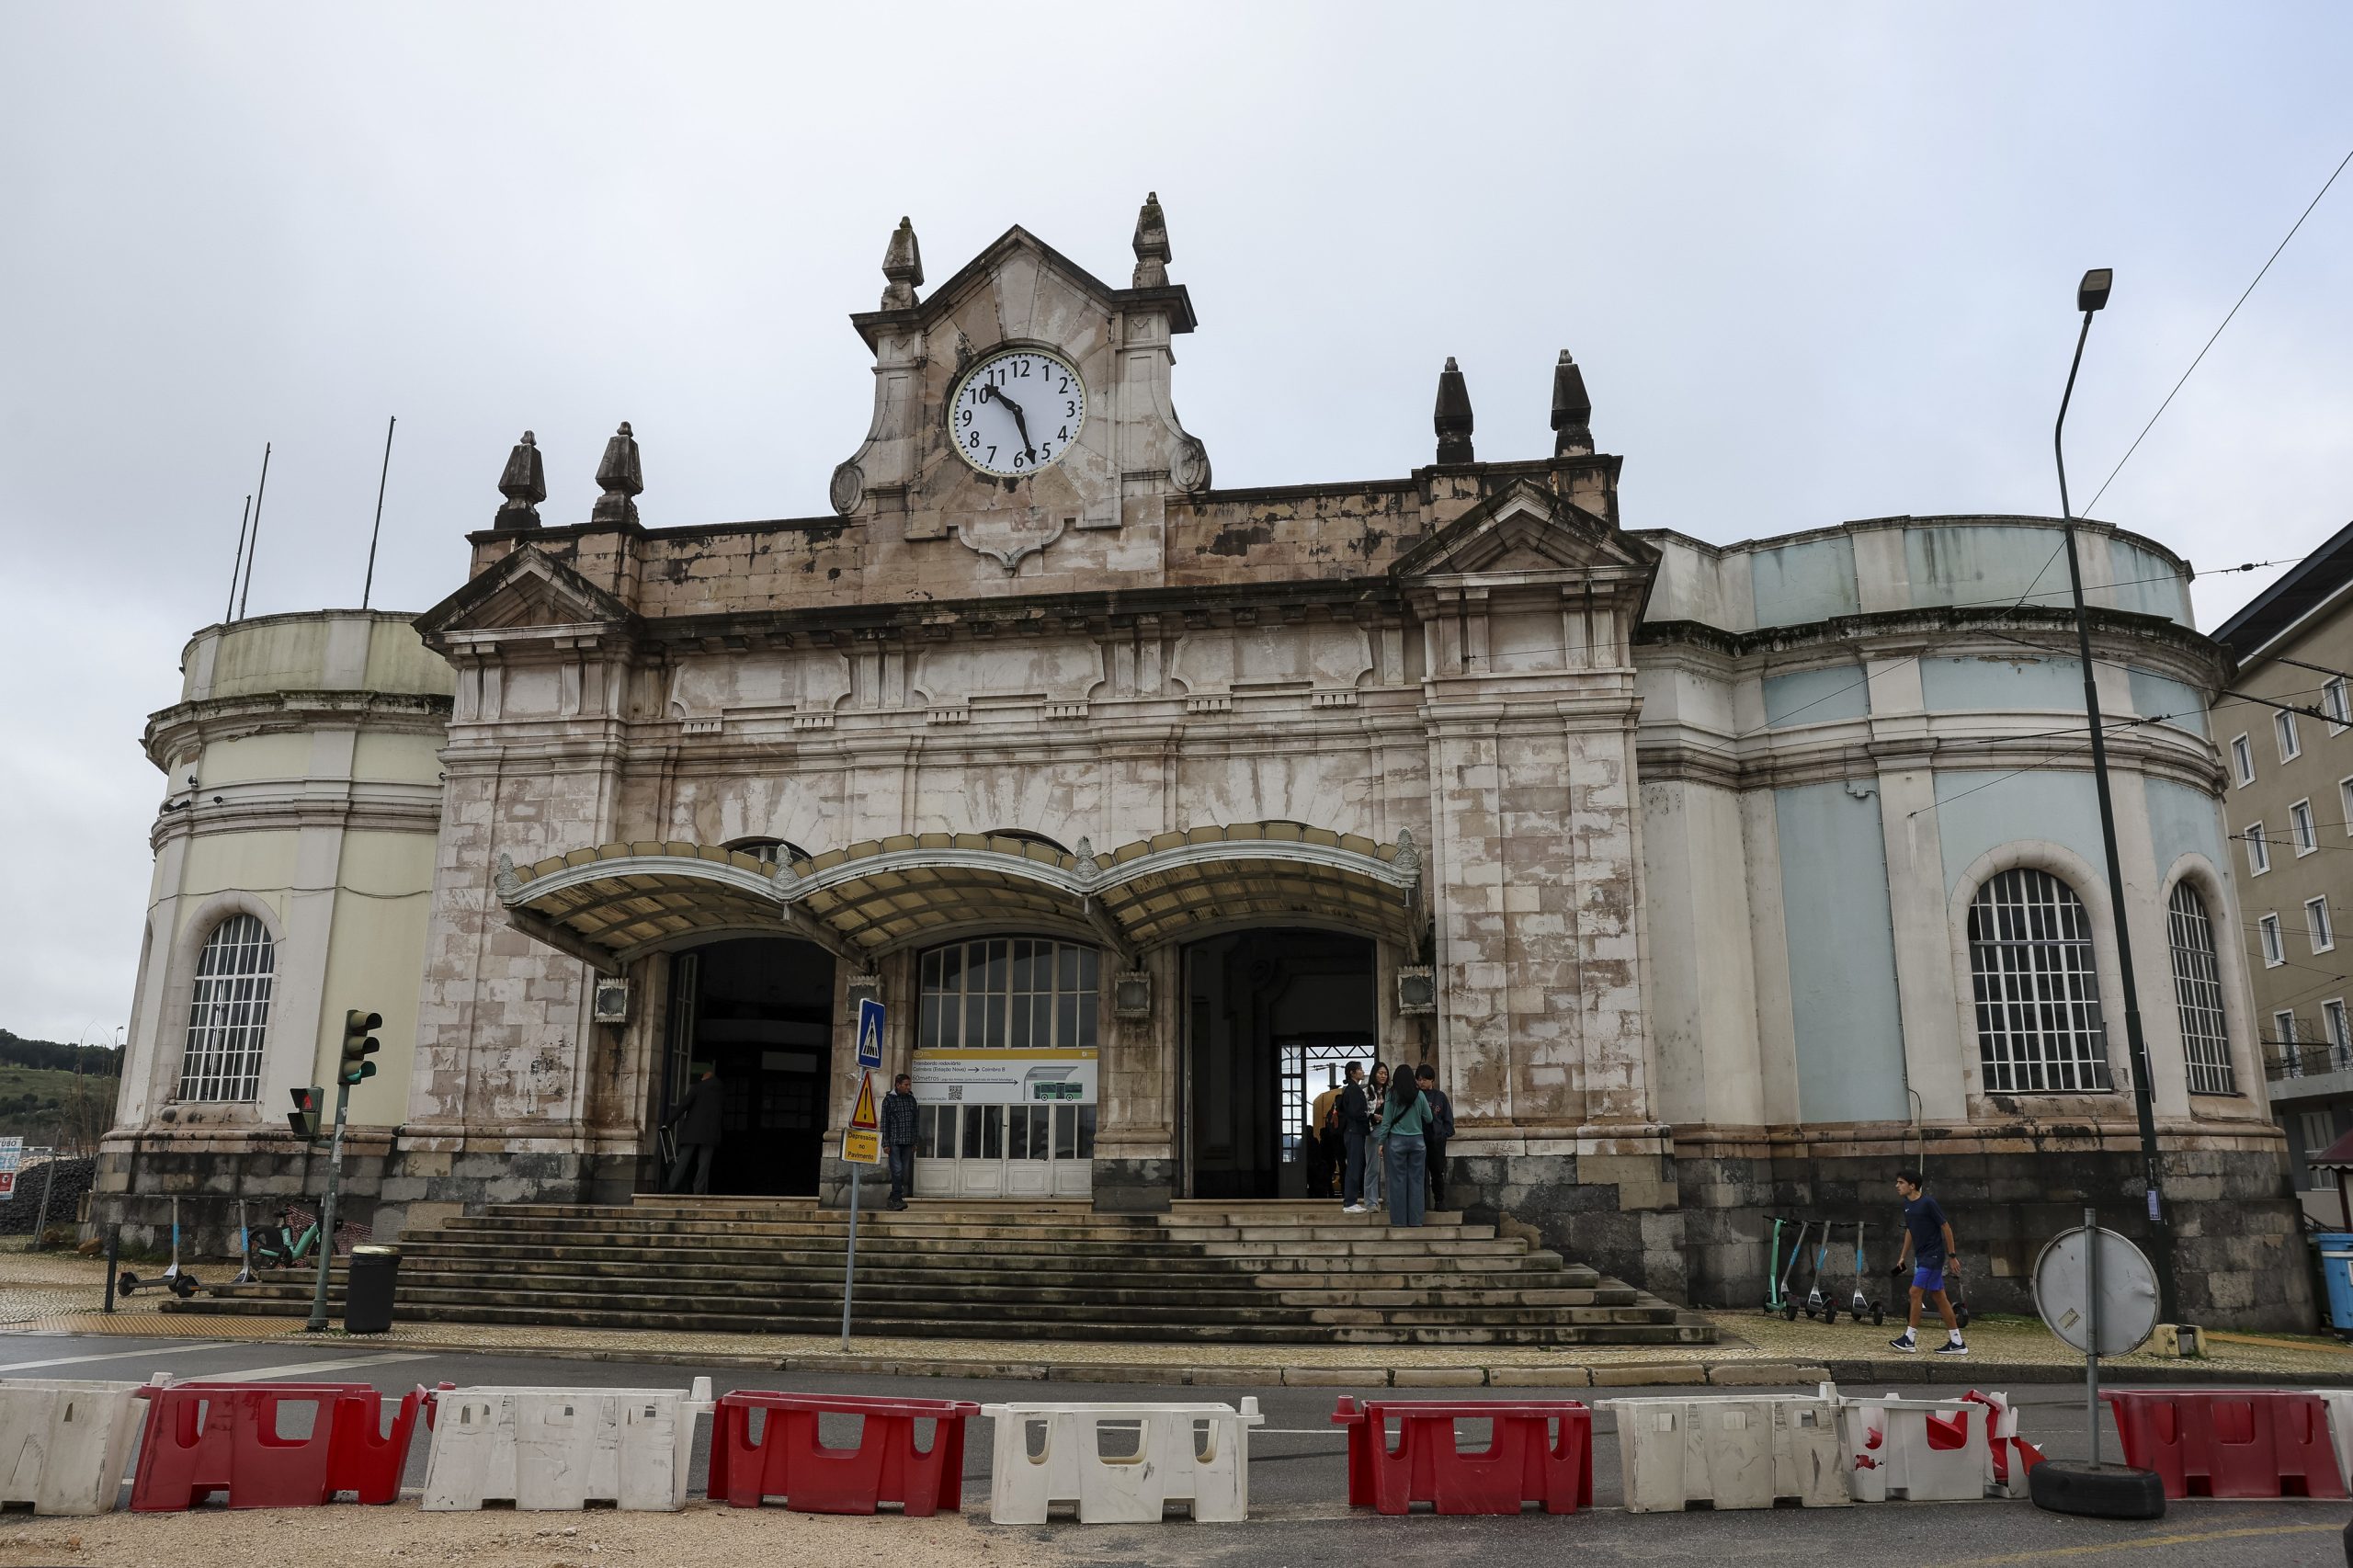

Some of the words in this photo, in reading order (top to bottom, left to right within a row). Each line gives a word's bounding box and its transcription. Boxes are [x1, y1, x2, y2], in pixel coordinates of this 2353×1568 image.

[1010, 359, 1030, 378] 12
[1042, 364, 1050, 381] 1
[987, 369, 1006, 386] 11
[1058, 377, 1069, 394] 2
[970, 388, 989, 405] 10
[1066, 400, 1075, 418] 3
[961, 409, 972, 427] 9
[970, 431, 980, 449] 8
[1057, 426, 1068, 443] 4
[986, 446, 997, 464] 7
[1013, 451, 1024, 468] 6
[1040, 442, 1051, 460] 5
[847, 1131, 877, 1141] Depressões
[847, 1151, 874, 1160] Pavimento
